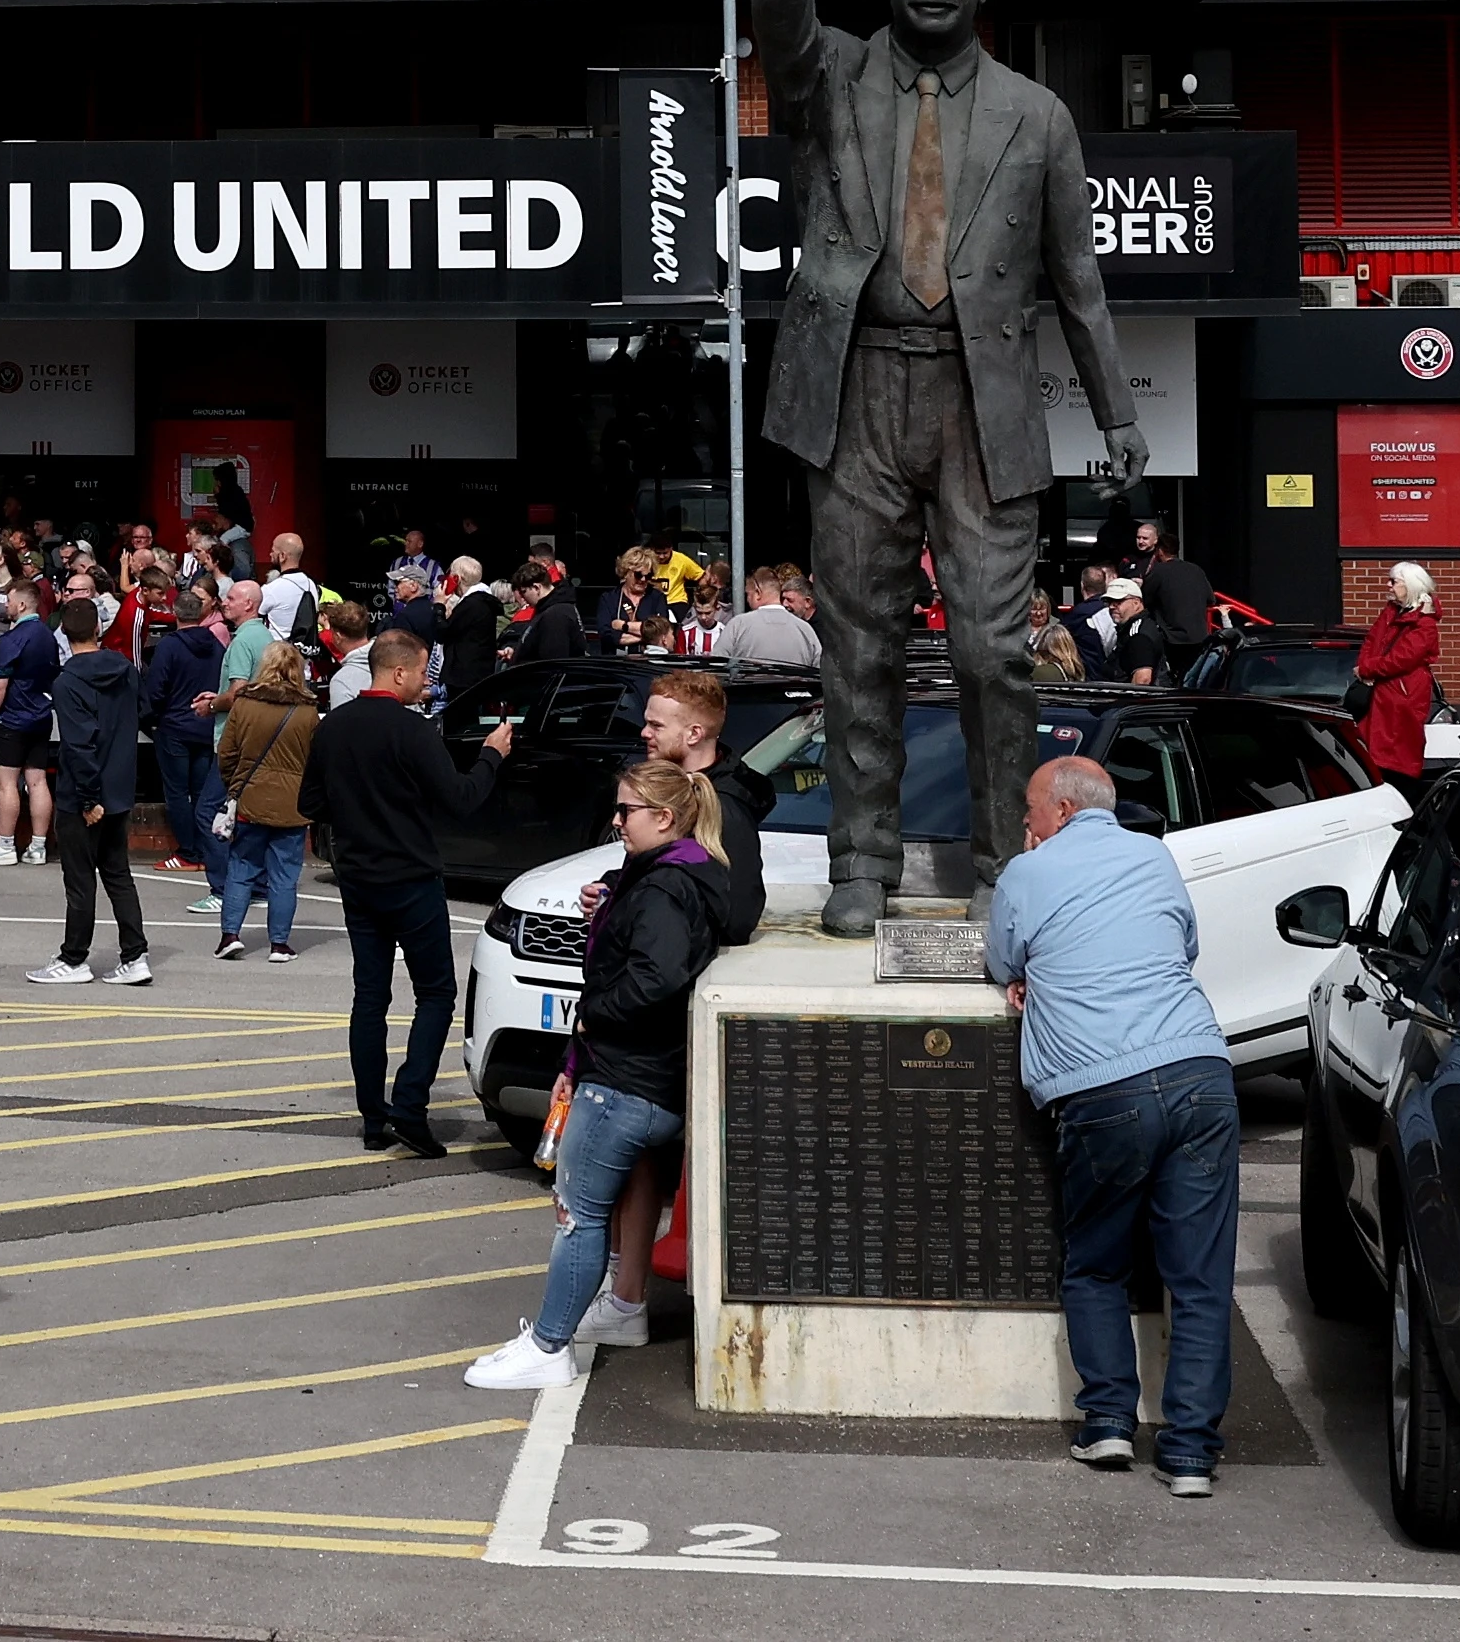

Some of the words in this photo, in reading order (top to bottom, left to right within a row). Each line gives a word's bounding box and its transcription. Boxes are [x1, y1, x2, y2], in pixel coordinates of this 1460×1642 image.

[648, 89, 688, 200] Arnold
[1085, 176, 1190, 209] ONAL
[1194, 175, 1214, 254] GROUP
[173, 179, 584, 272] UNITED
[1092, 212, 1190, 255] BER
[650, 200, 686, 284] Laver
[29, 364, 90, 376] TICKET
[407, 364, 471, 379] TICKET
[29, 379, 92, 392] OFFICE
[407, 381, 474, 396] OFFICE
[192, 408, 225, 416] GROUND
[225, 408, 246, 416] PLAN
[1370, 443, 1417, 453] FOLLOW
[1419, 443, 1436, 453] US
[1370, 454, 1382, 462] ON
[1384, 454, 1411, 462] SOCIAL
[1412, 454, 1436, 462] MEDIA
[74, 480, 99, 489] EXIT
[350, 483, 409, 491] ENTRANCE
[891, 929, 918, 939] Derek
[957, 929, 983, 939] MBE
[901, 1060, 943, 1070] WESTFIELD
[944, 1060, 975, 1070] HEALTH
[562, 1518, 782, 1559] 92
